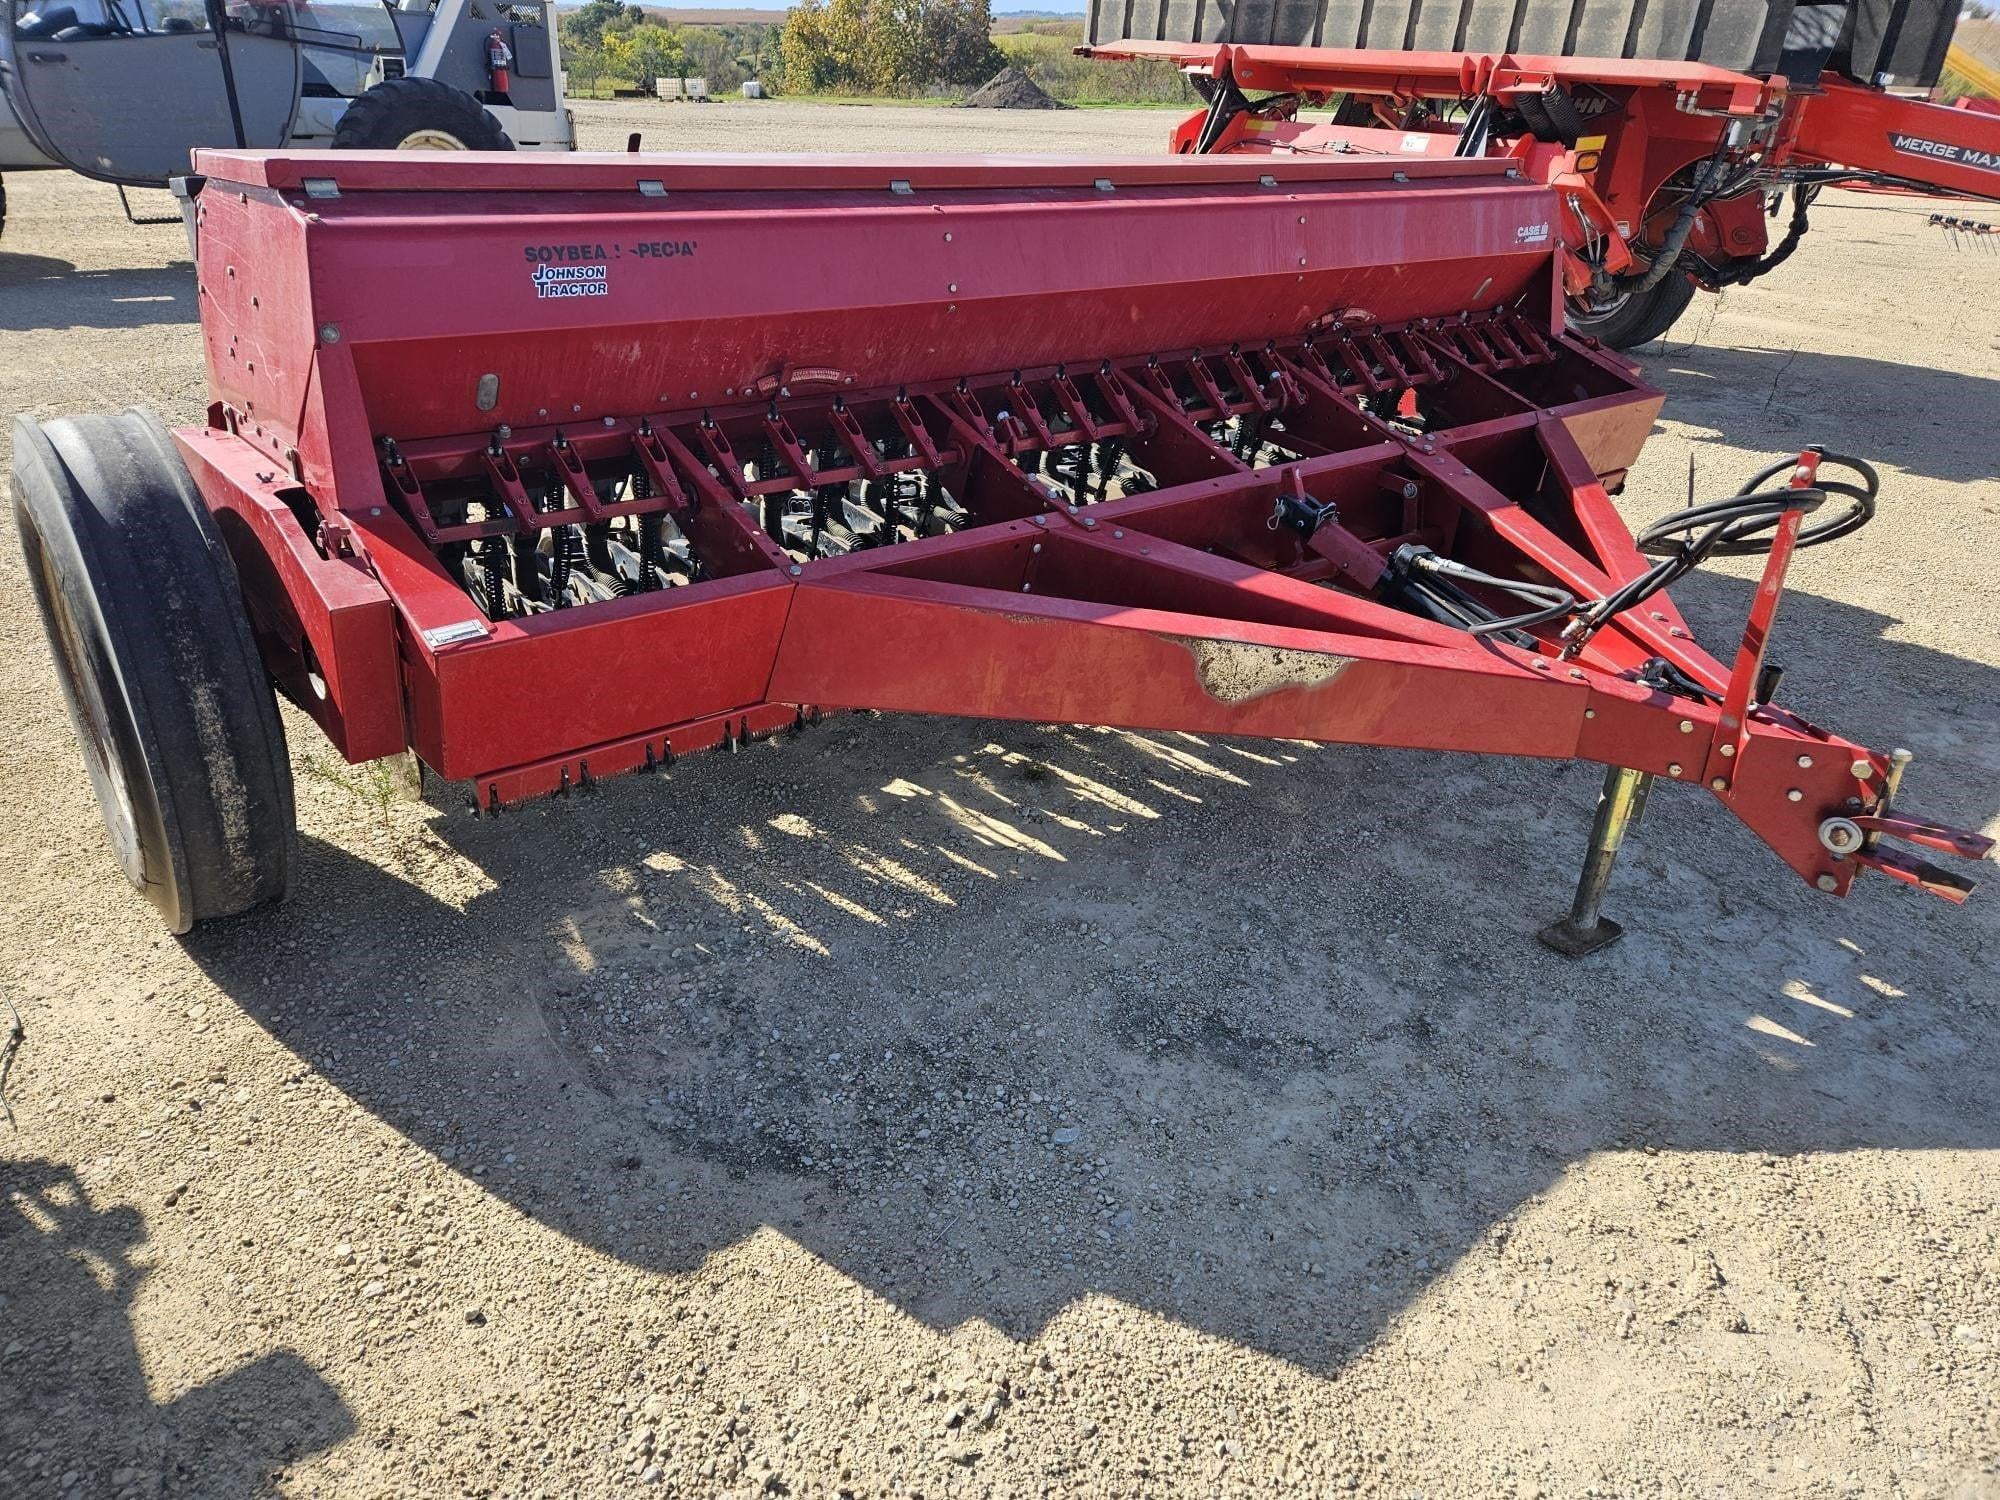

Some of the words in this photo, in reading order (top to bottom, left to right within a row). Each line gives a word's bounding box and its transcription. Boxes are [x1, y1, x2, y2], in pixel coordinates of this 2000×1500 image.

[1895, 135, 1959, 158] MERGE
[1517, 225, 1541, 238] CASE
[628, 241, 698, 258] PECIA
[532, 264, 607, 281] JOHNSON
[536, 281, 608, 297] TRACTOR
